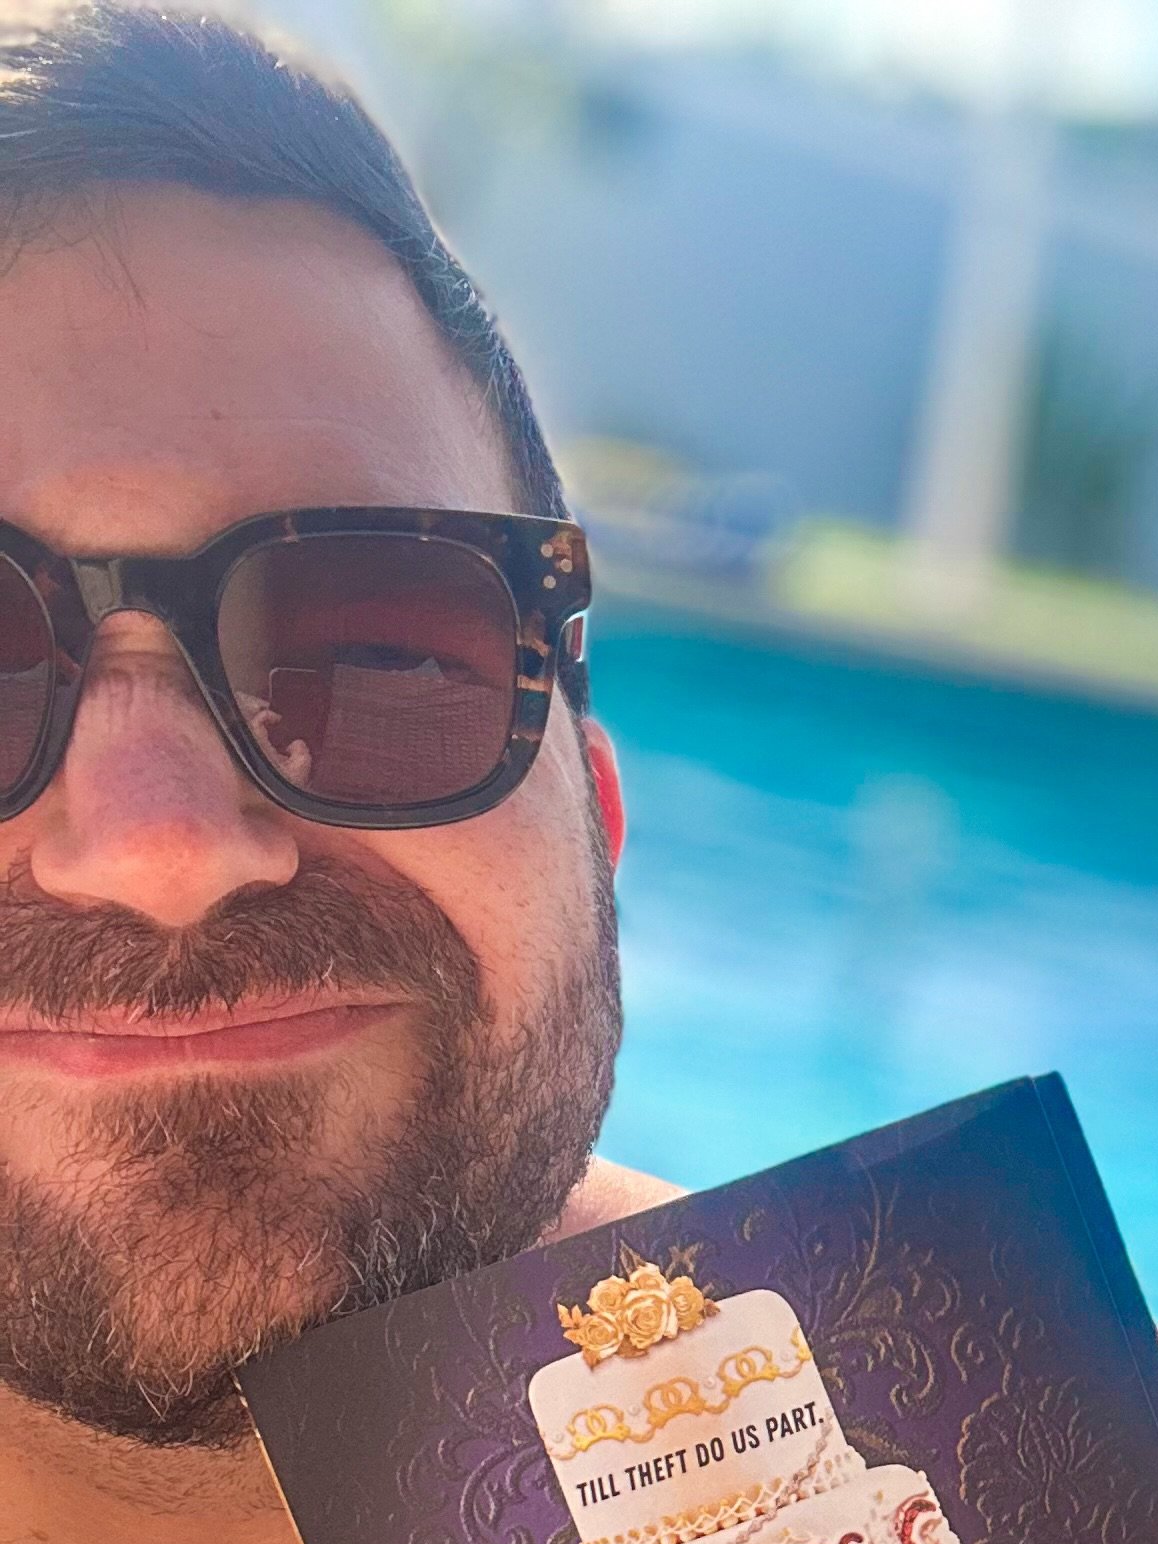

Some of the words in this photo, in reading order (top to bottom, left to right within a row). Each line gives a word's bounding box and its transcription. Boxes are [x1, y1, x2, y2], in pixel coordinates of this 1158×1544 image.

[576, 1476, 621, 1507] TILL
[625, 1449, 688, 1491] THEFT
[697, 1437, 725, 1467] DO
[731, 1424, 761, 1454] US
[766, 1401, 825, 1443] PART.
